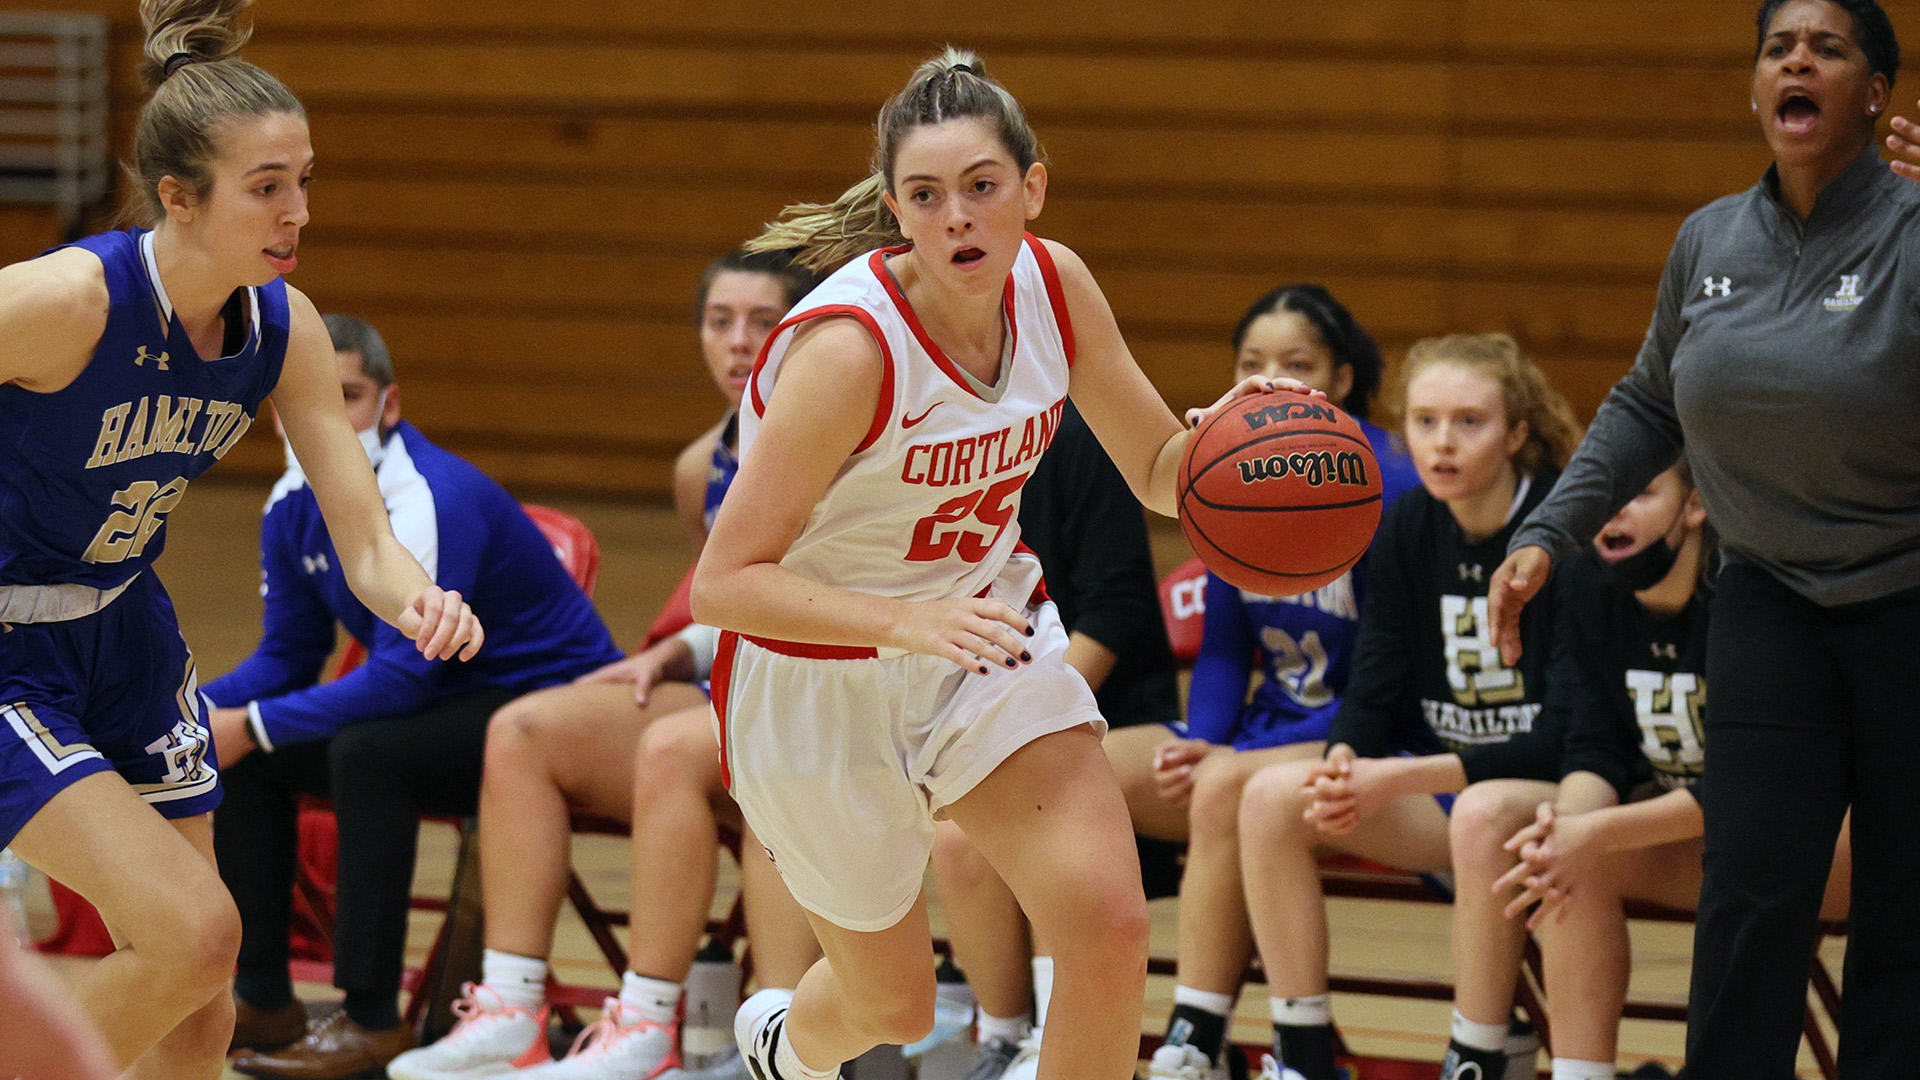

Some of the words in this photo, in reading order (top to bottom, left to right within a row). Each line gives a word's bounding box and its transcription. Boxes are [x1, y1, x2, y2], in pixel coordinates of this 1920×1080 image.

[85, 395, 255, 469] HAMITON
[1243, 402, 1337, 431] NCAA
[1237, 450, 1369, 488] Wilson
[904, 471, 1031, 563] 25
[1625, 669, 1706, 775] H
